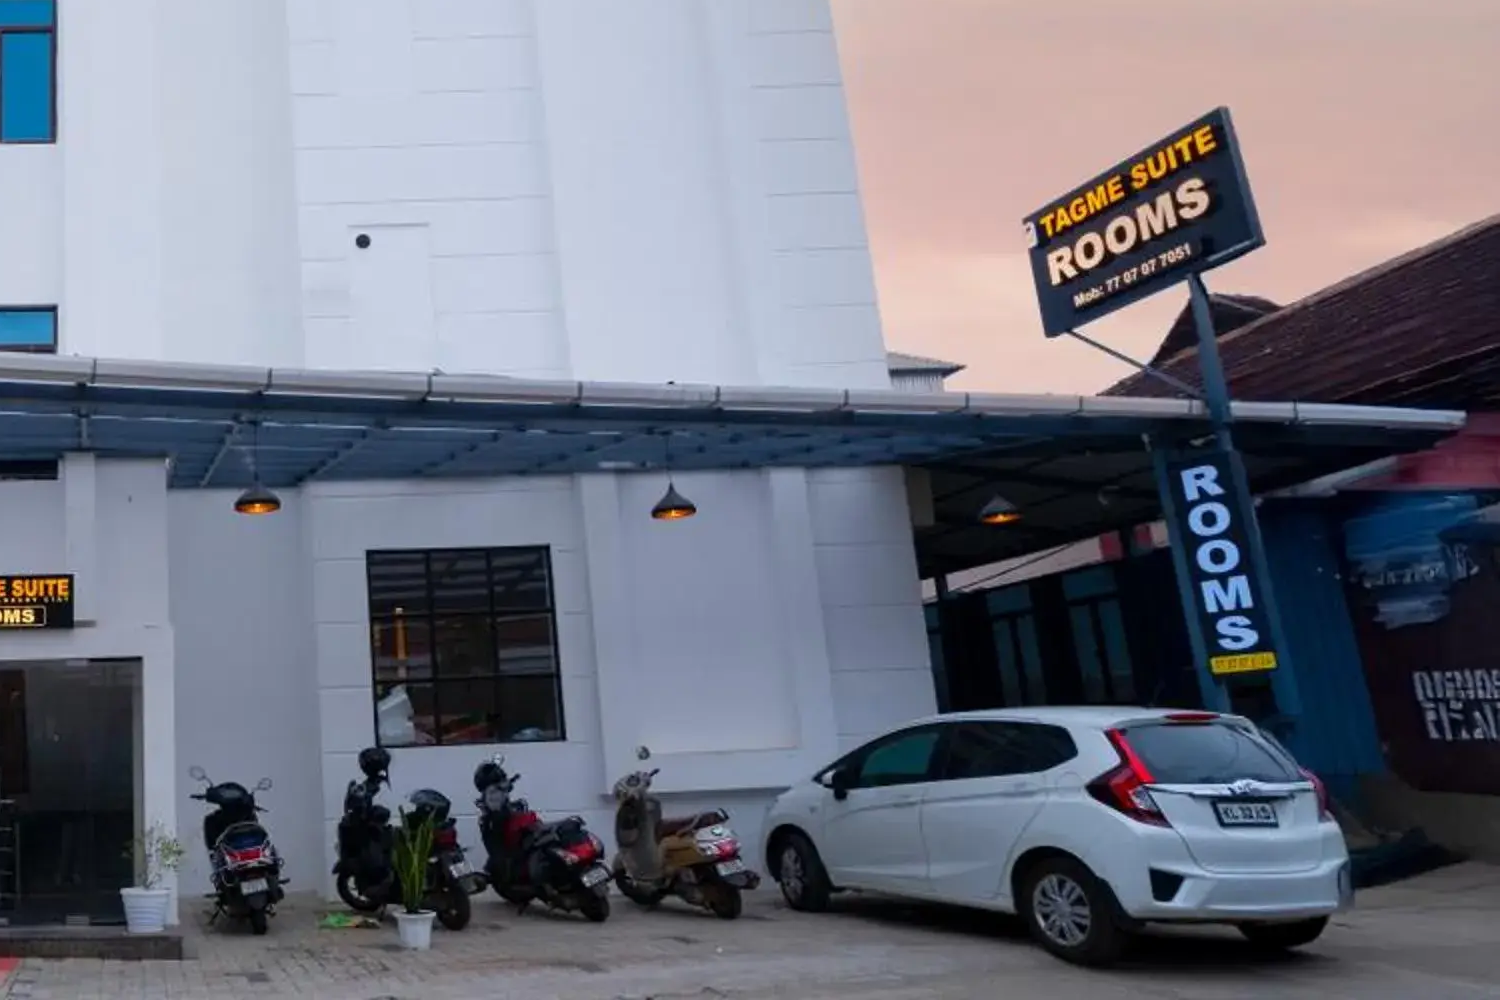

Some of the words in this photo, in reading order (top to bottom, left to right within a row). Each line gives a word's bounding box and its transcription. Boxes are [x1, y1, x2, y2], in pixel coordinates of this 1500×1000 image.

[1040, 175, 1125, 238] TAGME
[1130, 125, 1216, 190] SUITE
[1046, 178, 1210, 286] ROOMS
[12, 578, 69, 597] SUITE
[1180, 464, 1259, 650] ROOMS
